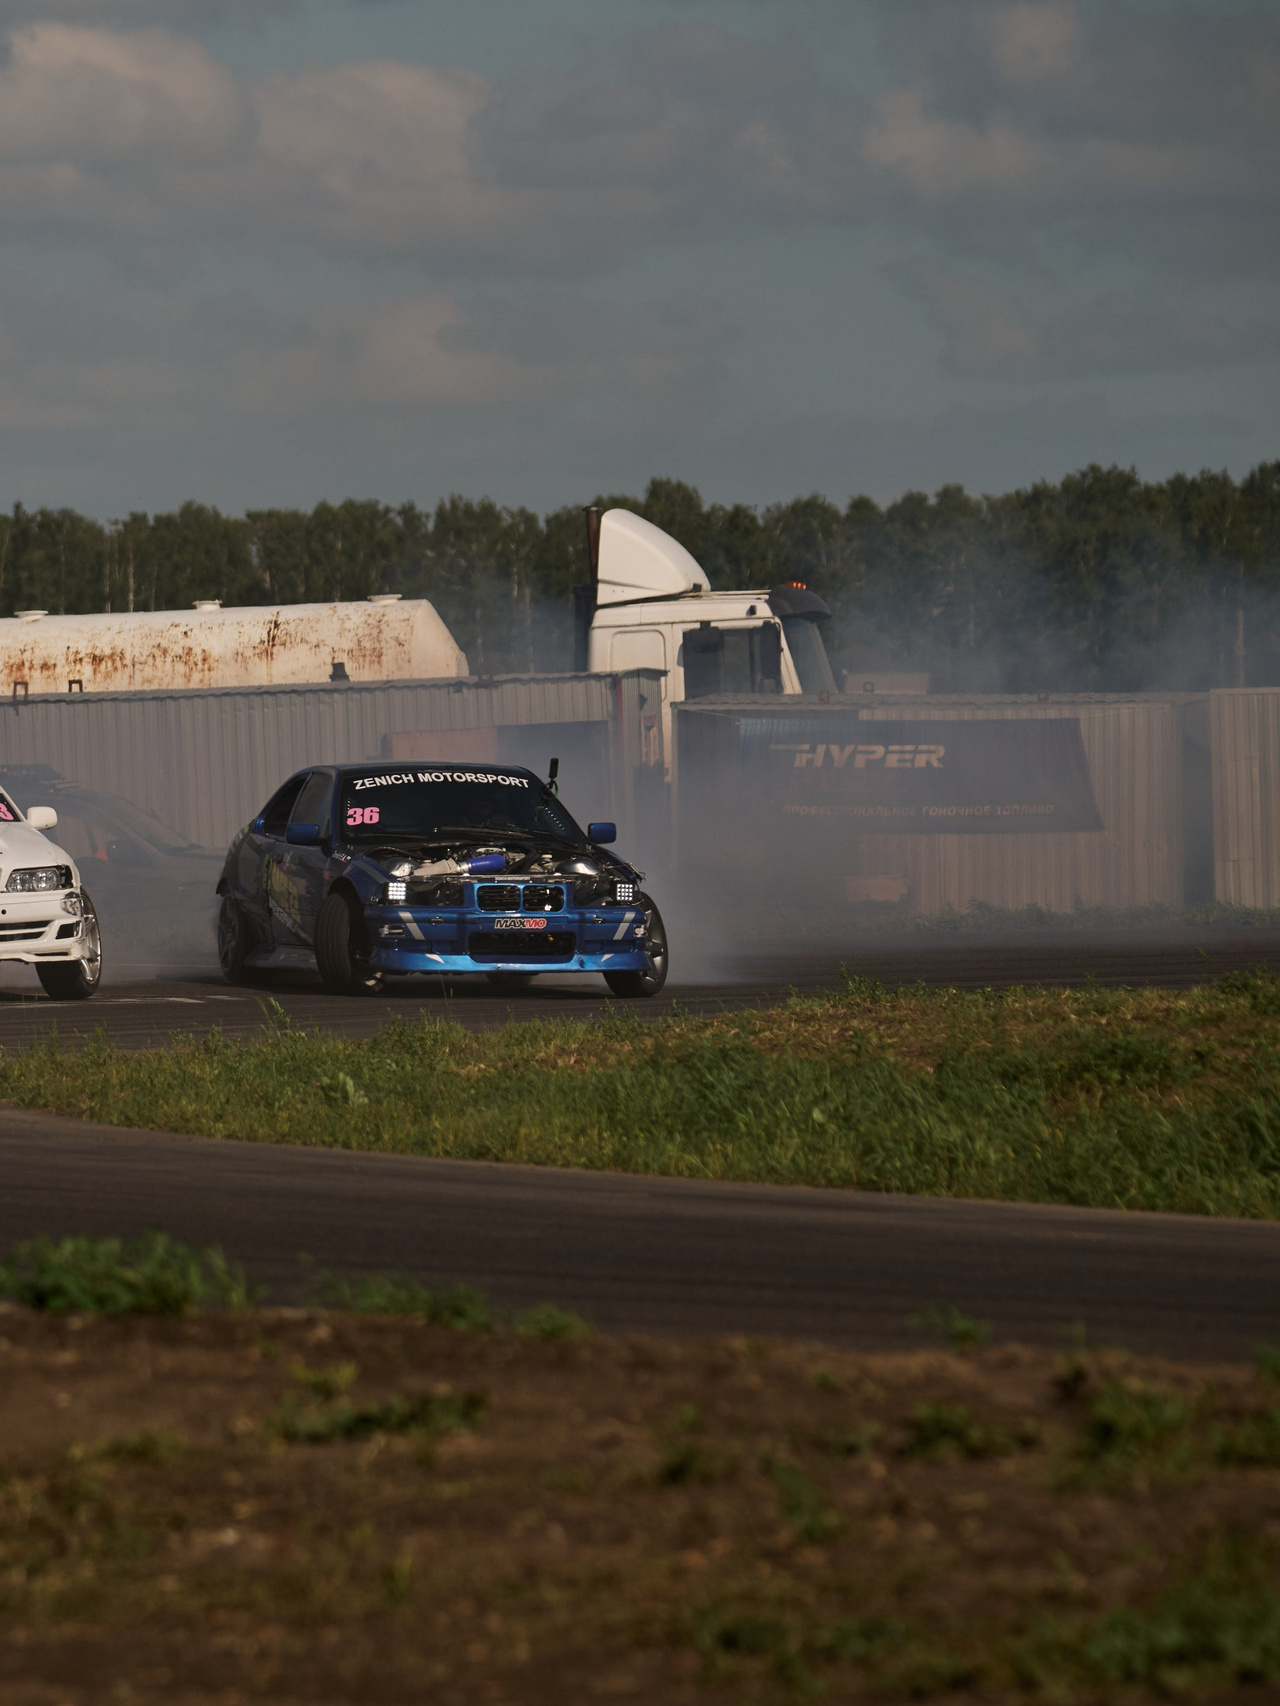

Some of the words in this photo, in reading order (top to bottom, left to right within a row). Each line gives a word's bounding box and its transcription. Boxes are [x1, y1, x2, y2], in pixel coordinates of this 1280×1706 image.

[793, 743, 946, 768] HYPER
[353, 773, 415, 791] ZENICH
[417, 772, 530, 789] MOTORSPORT
[346, 806, 380, 826] 36
[782, 805, 916, 816] ПРОФЕССИОНАЛЬНОЕ
[922, 805, 991, 816] ГОНОЧНОЕ
[995, 804, 1054, 815] ТОПЛИВО
[494, 918, 548, 929] MAXMO
